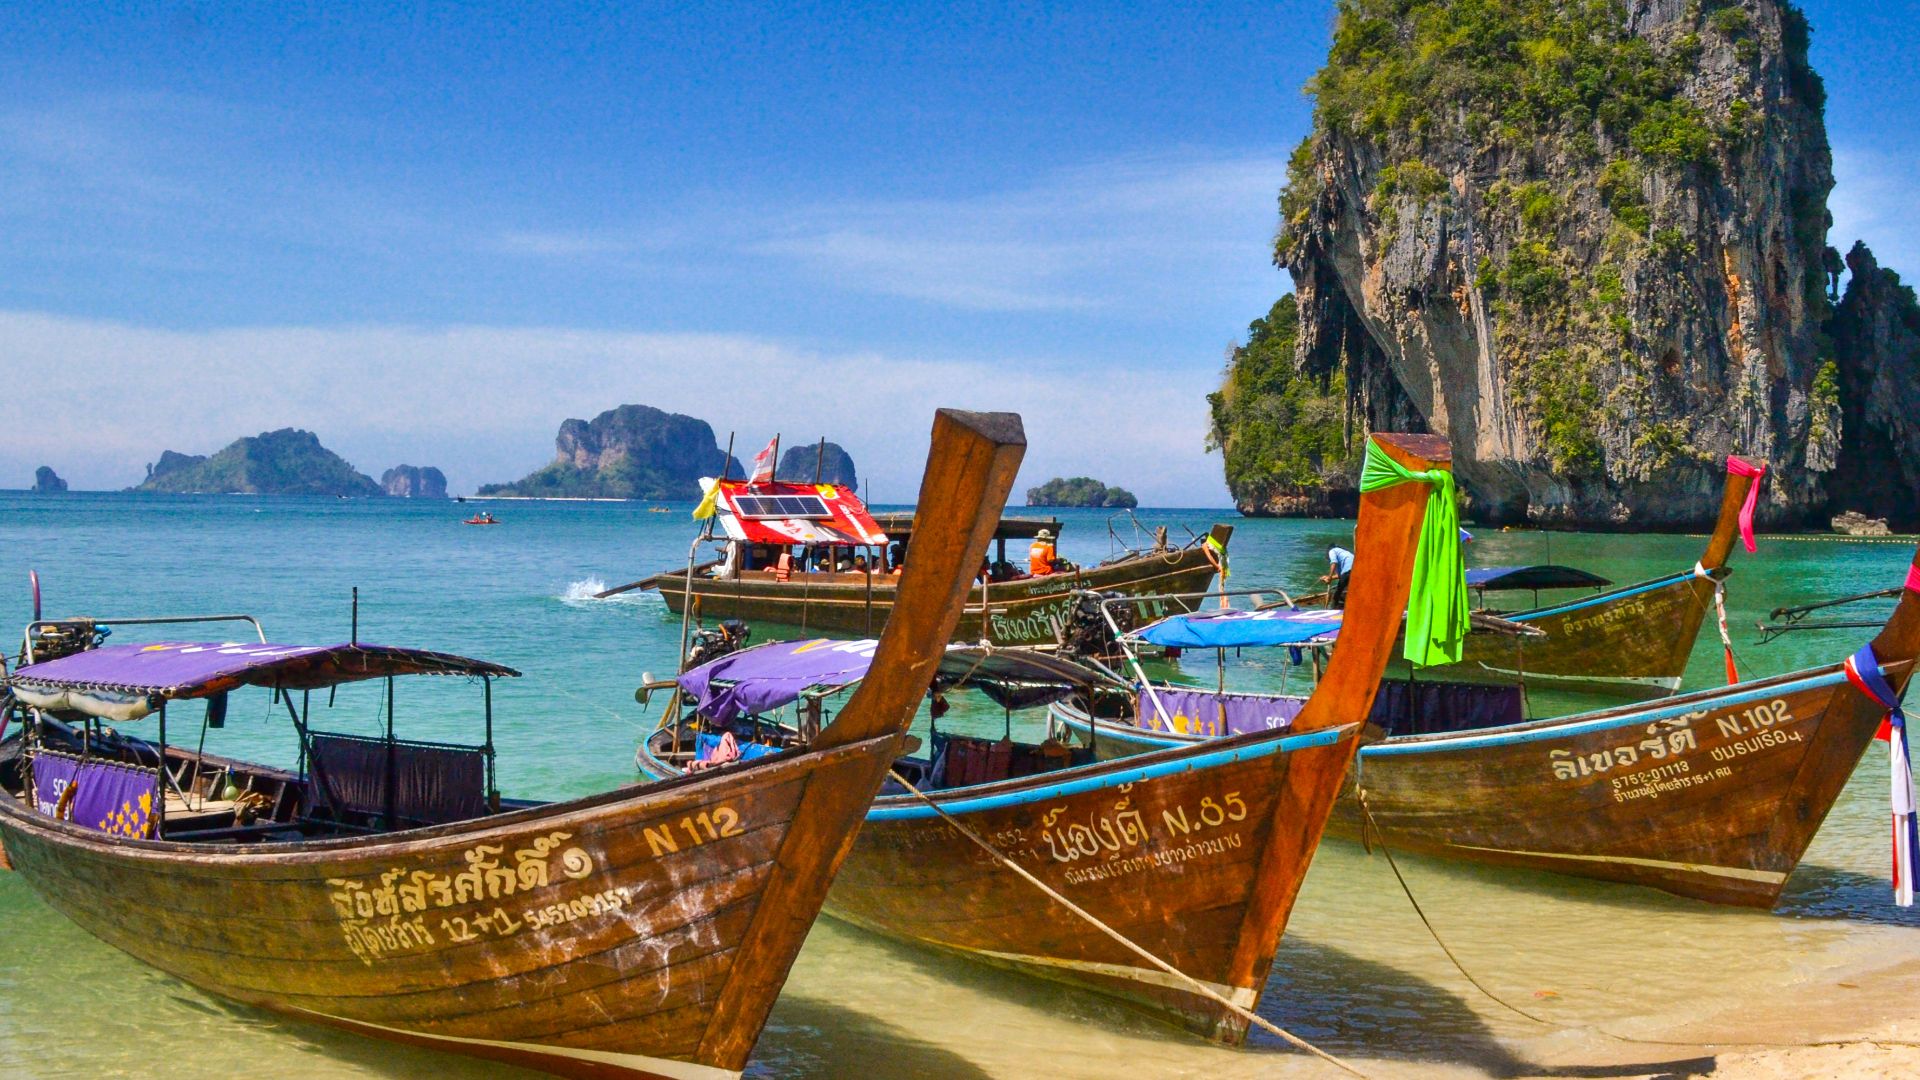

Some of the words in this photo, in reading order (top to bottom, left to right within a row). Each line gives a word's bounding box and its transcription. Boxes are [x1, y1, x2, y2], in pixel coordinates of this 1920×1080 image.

[1716, 699, 1793, 738] N.102
[1612, 760, 1690, 789] 5752-01113
[643, 825, 678, 858] N
[680, 807, 745, 846] 112
[1162, 791, 1247, 838] N.85
